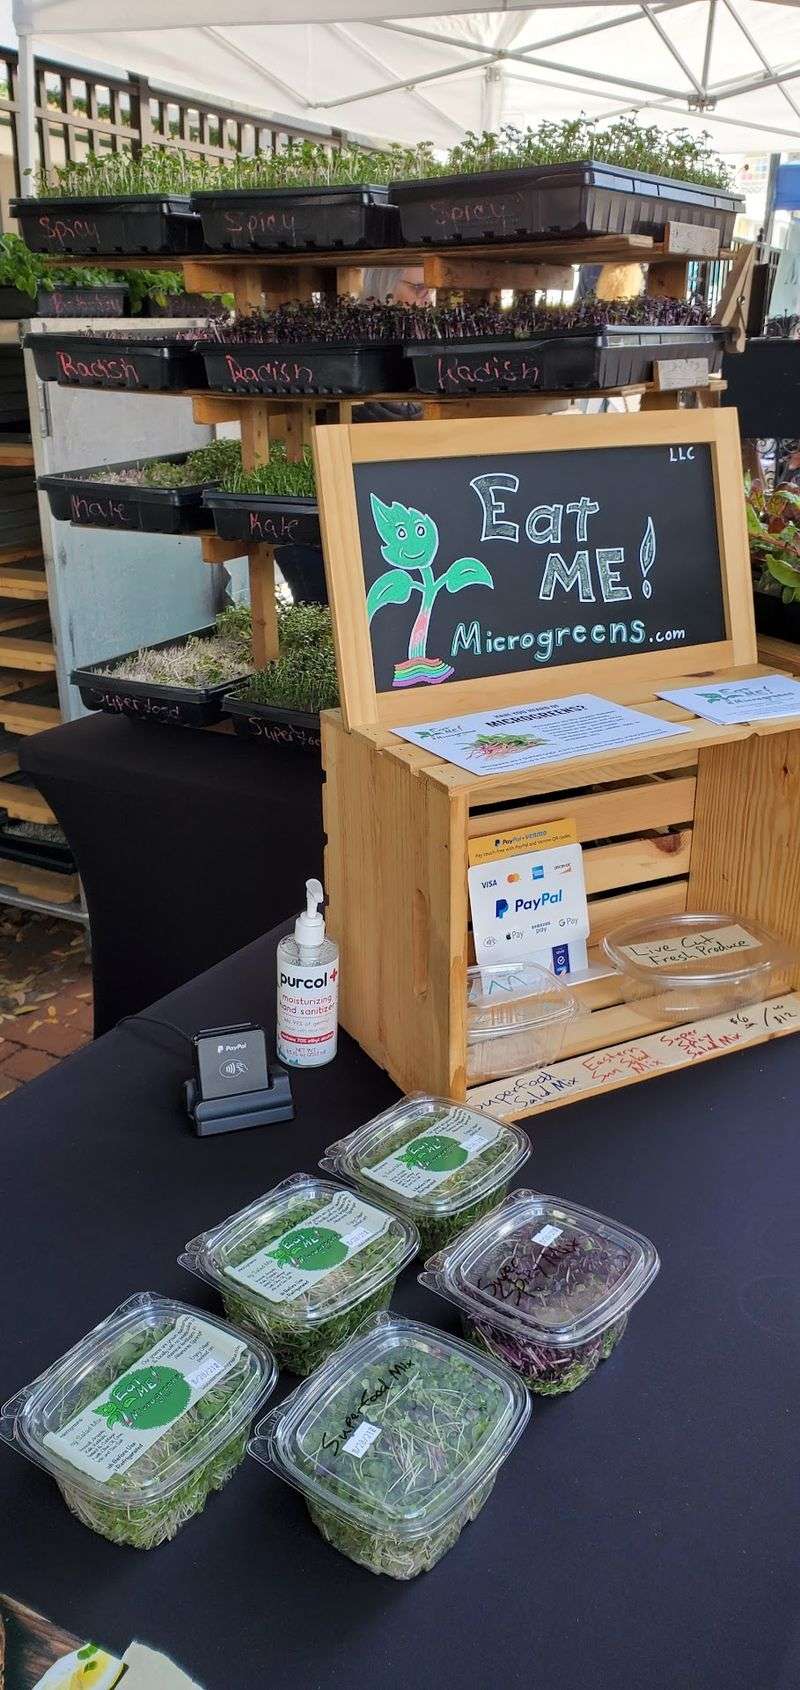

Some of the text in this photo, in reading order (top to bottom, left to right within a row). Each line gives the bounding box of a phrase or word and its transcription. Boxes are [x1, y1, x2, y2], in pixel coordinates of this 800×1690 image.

[38, 215, 99, 243] Spicy
[223, 212, 296, 244] Spicy
[56, 351, 139, 383] Radish
[225, 353, 313, 385] Radish
[436, 356, 539, 389] Radish
[669, 447, 695, 462] LLC
[469, 472, 599, 544] Eat
[539, 517, 656, 603] ME!
[481, 880, 498, 889] VISA
[515, 889, 562, 912] PayPal
[629, 934, 715, 956] Live Cut
[649, 940, 751, 965] Fresh Produce
[282, 994, 333, 1006] moisturizing
[300, 1003, 335, 1016] sanitizer
[225, 1042, 246, 1052] PayPal
[582, 1046, 640, 1072] Eastern
[514, 1076, 579, 1108] Salad Mix
[389, 1359, 415, 1381] Mix
[112, 1378, 141, 1401] Eat
